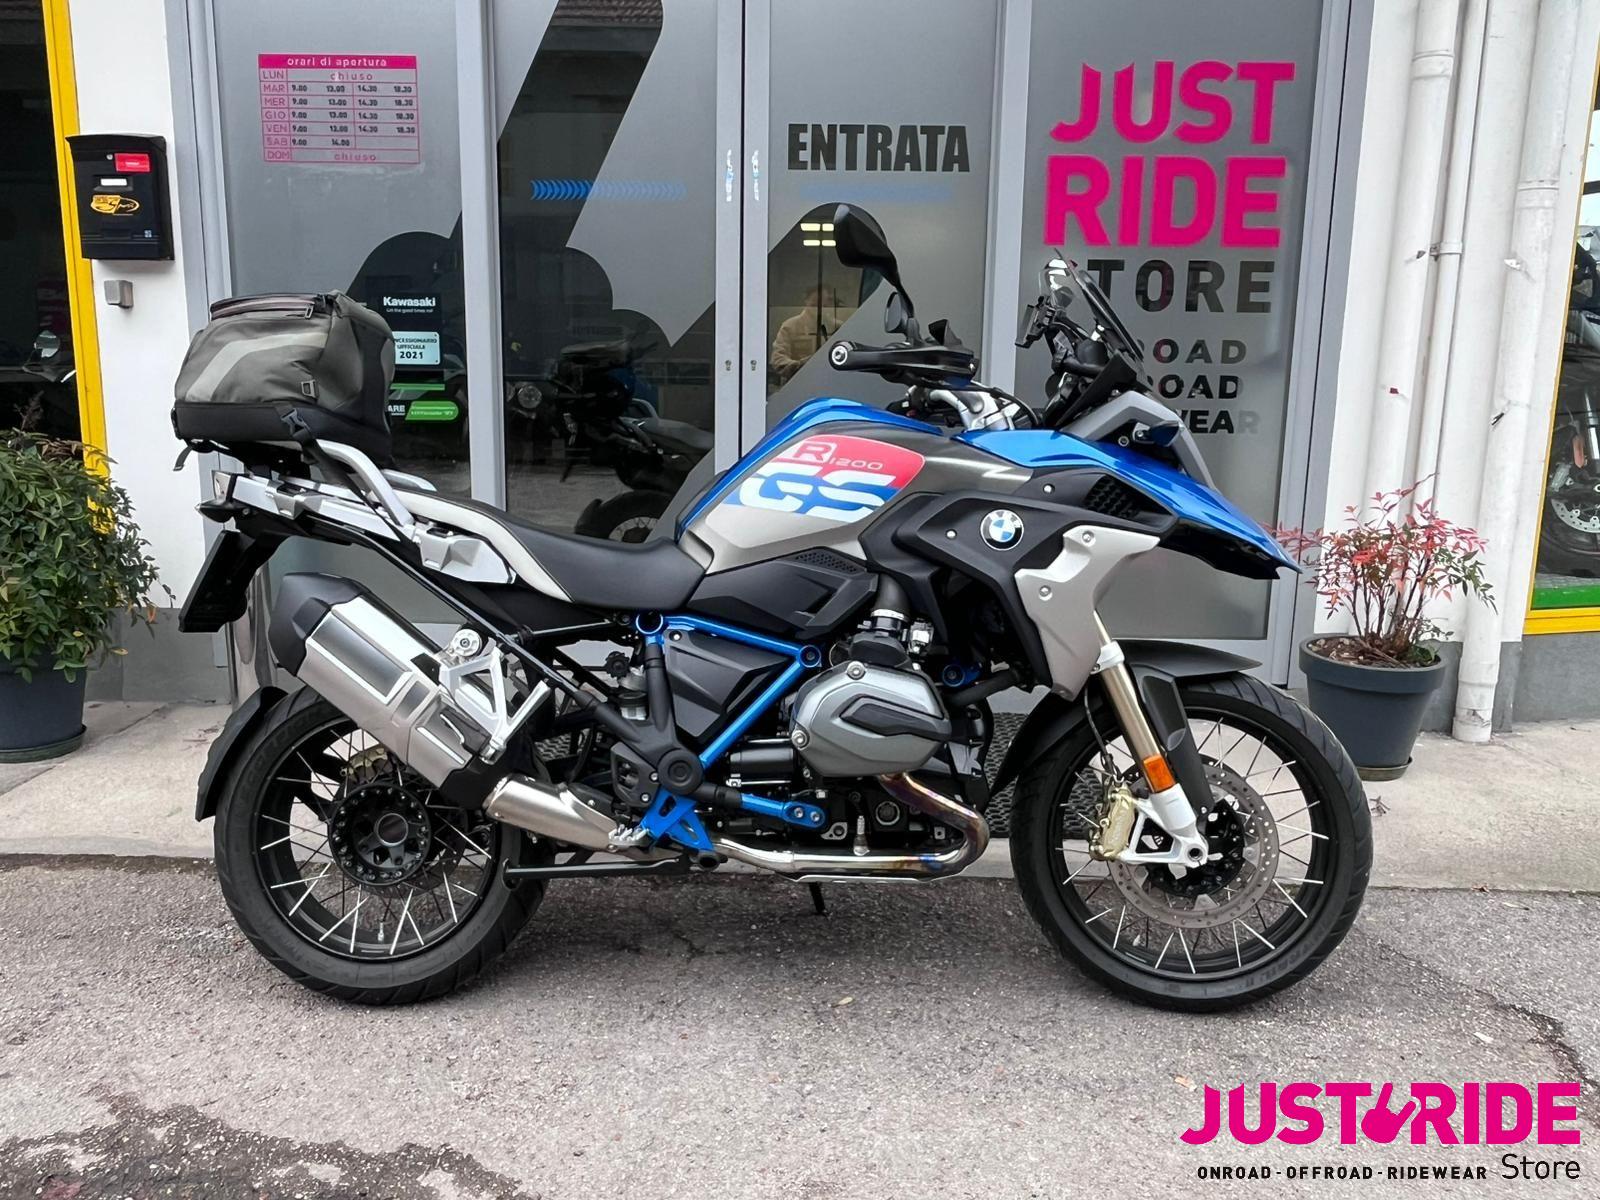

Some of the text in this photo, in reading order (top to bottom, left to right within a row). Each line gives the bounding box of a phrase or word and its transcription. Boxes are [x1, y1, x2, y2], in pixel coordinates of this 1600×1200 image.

[287, 57, 388, 68] orari di apertura
[262, 70, 373, 81] LUN chiuso
[263, 84, 285, 93] MAR
[264, 97, 286, 106] MER
[1049, 60, 1296, 144] JUST
[264, 110, 286, 120] GIO
[266, 124, 287, 133] VEN
[266, 137, 288, 146] SAB
[788, 123, 970, 173] ENTRATA
[267, 150, 376, 161] DOM chiuso
[1043, 154, 1287, 248] RIDE
[1086, 259, 1276, 313] TORE
[383, 296, 436, 307] Kawasaki
[399, 351, 424, 359] 2021
[1137, 338, 1247, 364] OAD
[1148, 373, 1244, 400] OAD
[387, 404, 406, 413] ARE
[1181, 409, 1261, 434] EAR
[829, 457, 884, 471] 1200
[738, 461, 897, 524] GS
